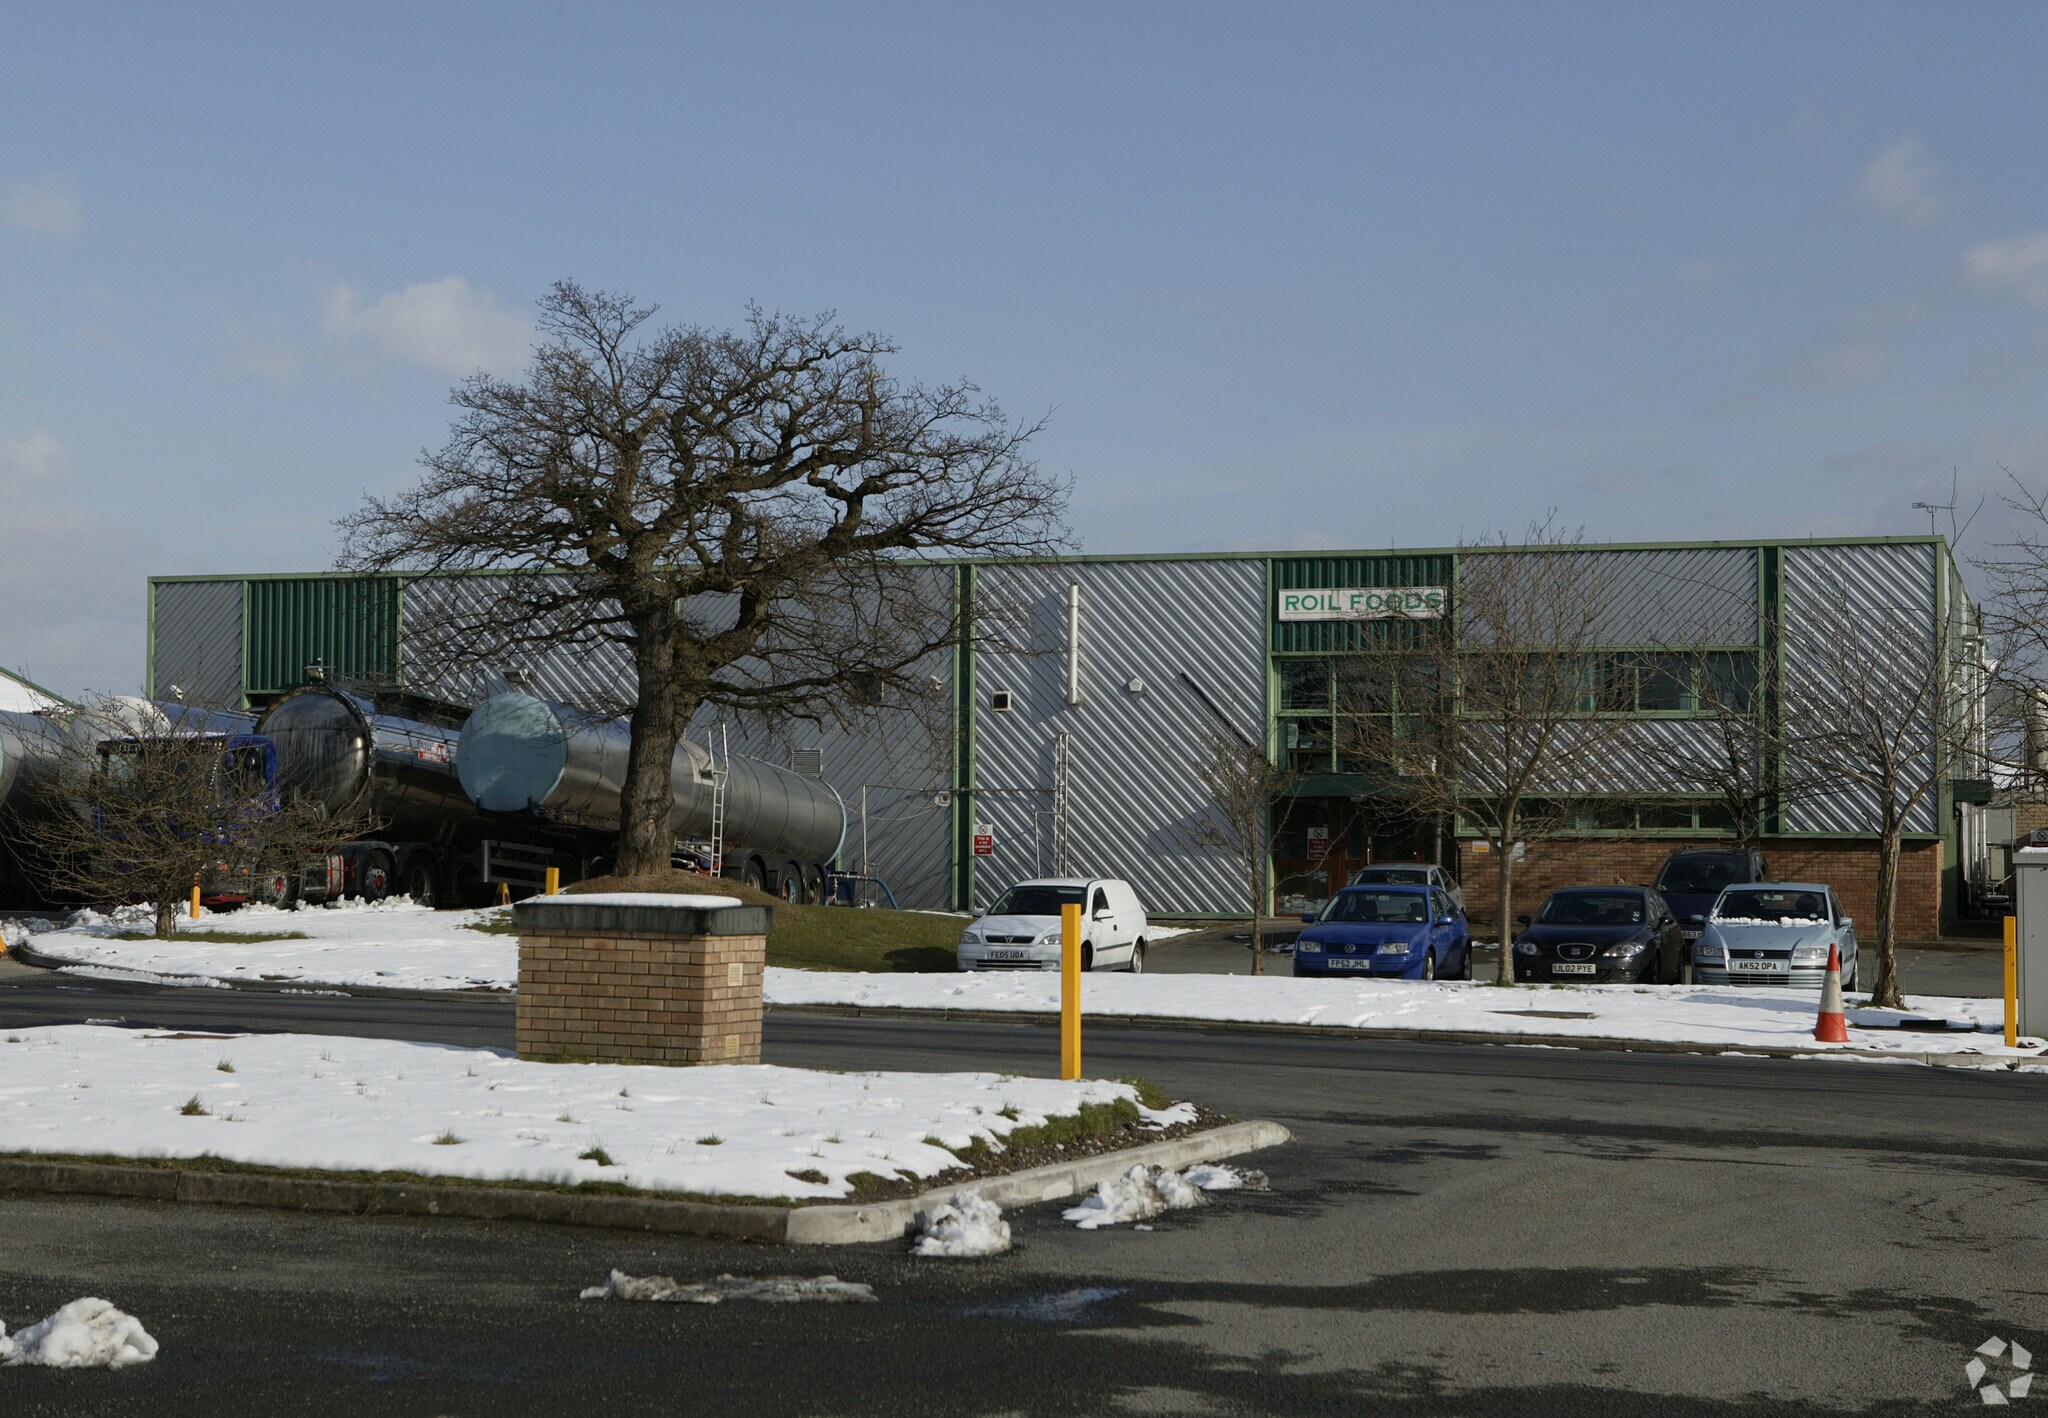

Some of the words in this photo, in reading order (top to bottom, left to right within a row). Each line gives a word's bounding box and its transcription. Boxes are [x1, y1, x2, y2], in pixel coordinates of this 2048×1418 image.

[1284, 594, 1341, 611] ROIL
[1350, 592, 1441, 609] FOODS
[990, 951, 1009, 959] FE05
[1330, 960, 1350, 968] FP52
[1352, 960, 1366, 968] JHL
[1738, 962, 1760, 970] AK52
[1761, 962, 1777, 970] OPA
[1577, 964, 1593, 973] PYE
